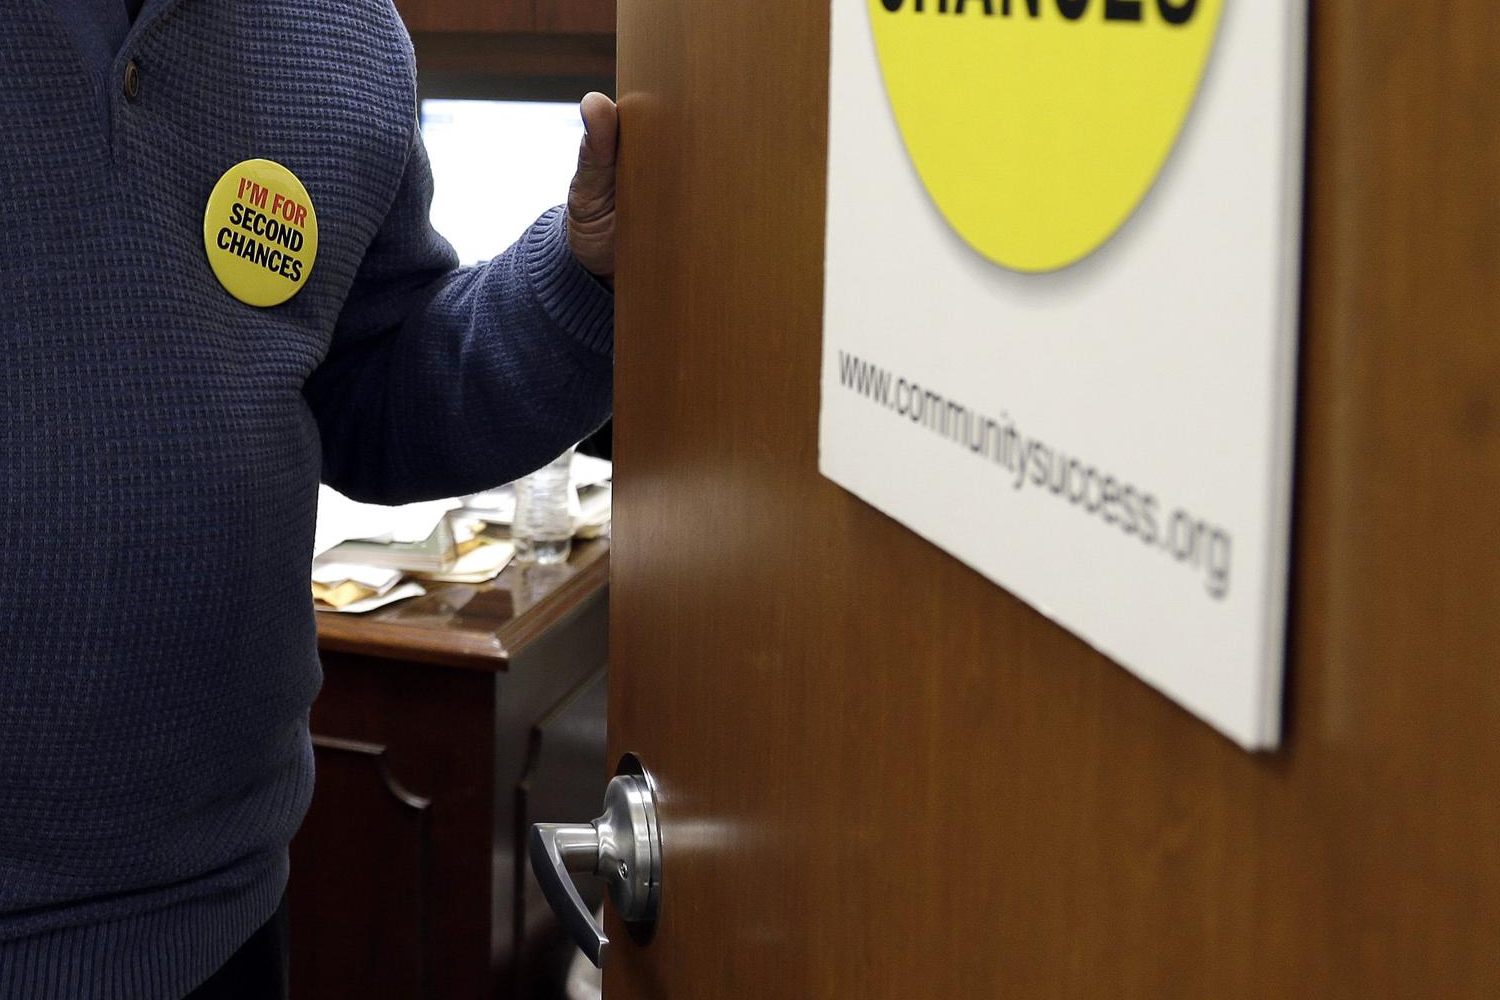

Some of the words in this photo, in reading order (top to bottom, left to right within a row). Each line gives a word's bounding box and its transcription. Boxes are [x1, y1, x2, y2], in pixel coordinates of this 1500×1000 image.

[229, 202, 304, 253] SECOND
[237, 177, 269, 210] I'M
[271, 193, 308, 230] FOR
[216, 227, 303, 283] CHANCES
[837, 348, 1234, 601] www.communitysuccess.org
